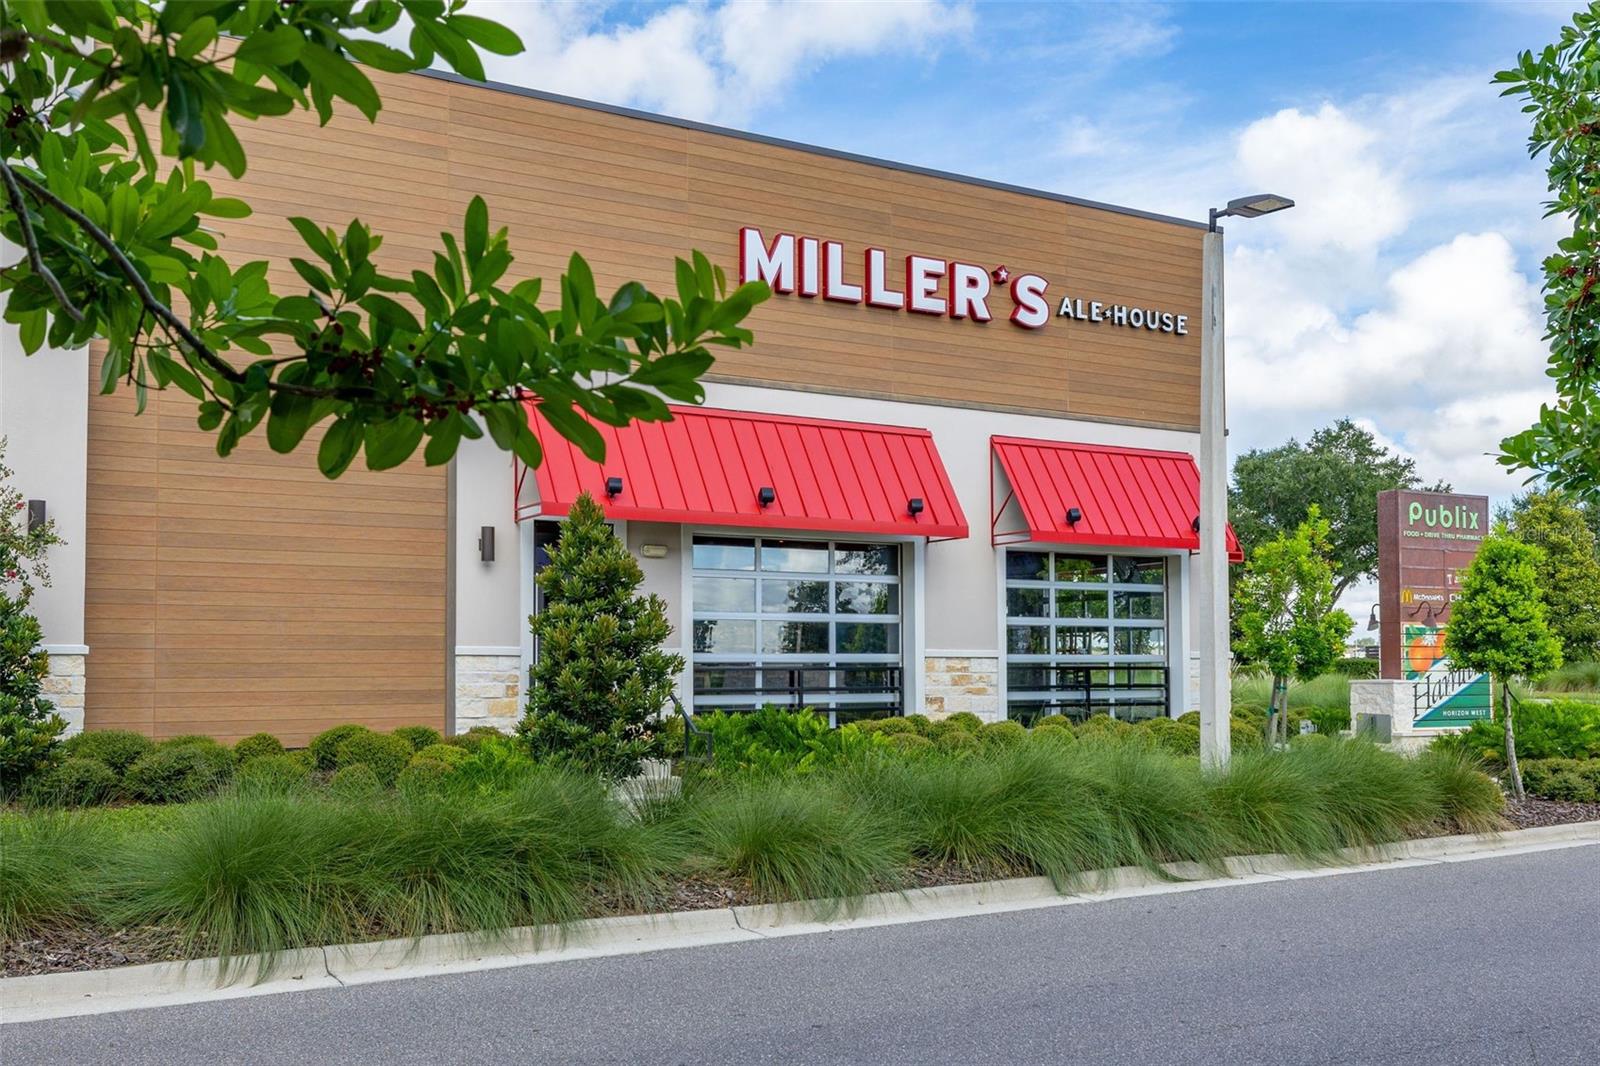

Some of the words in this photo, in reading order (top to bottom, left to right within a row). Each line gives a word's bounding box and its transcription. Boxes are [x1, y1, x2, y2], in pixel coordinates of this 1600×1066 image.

[739, 227, 1050, 330] MILLER'S
[1057, 296, 1104, 322] ALE
[1111, 304, 1188, 336] HOUSE
[1408, 501, 1479, 530] Publix
